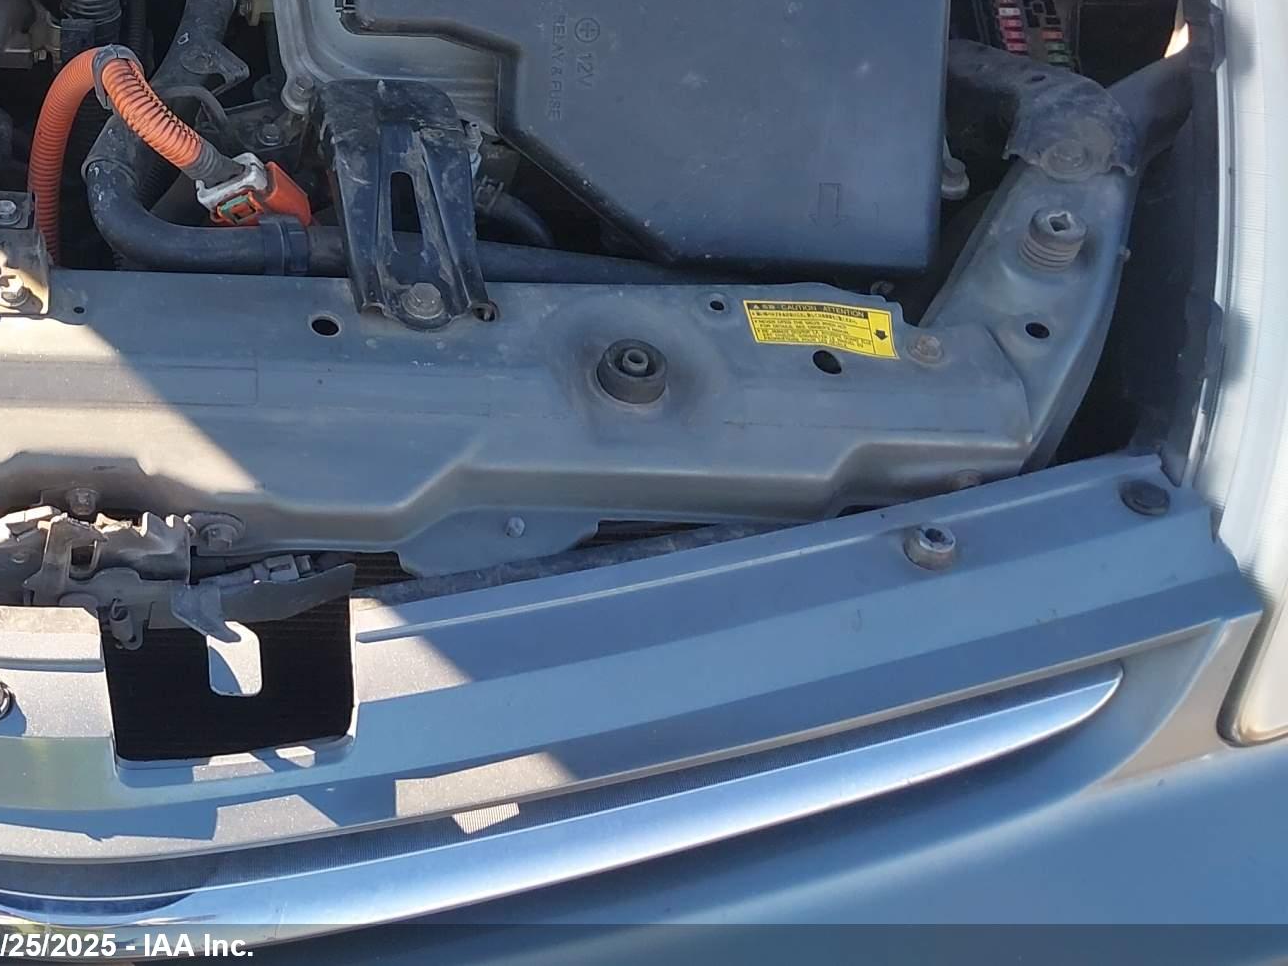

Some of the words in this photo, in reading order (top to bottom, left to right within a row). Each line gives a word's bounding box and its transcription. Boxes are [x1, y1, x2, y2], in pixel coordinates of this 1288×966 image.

[551, 14, 566, 61] RELAY
[575, 52, 593, 88] 12V
[547, 80, 562, 121] FUSE
[781, 304, 817, 312] CAUTION
[822, 305, 865, 318] ATTENTION
